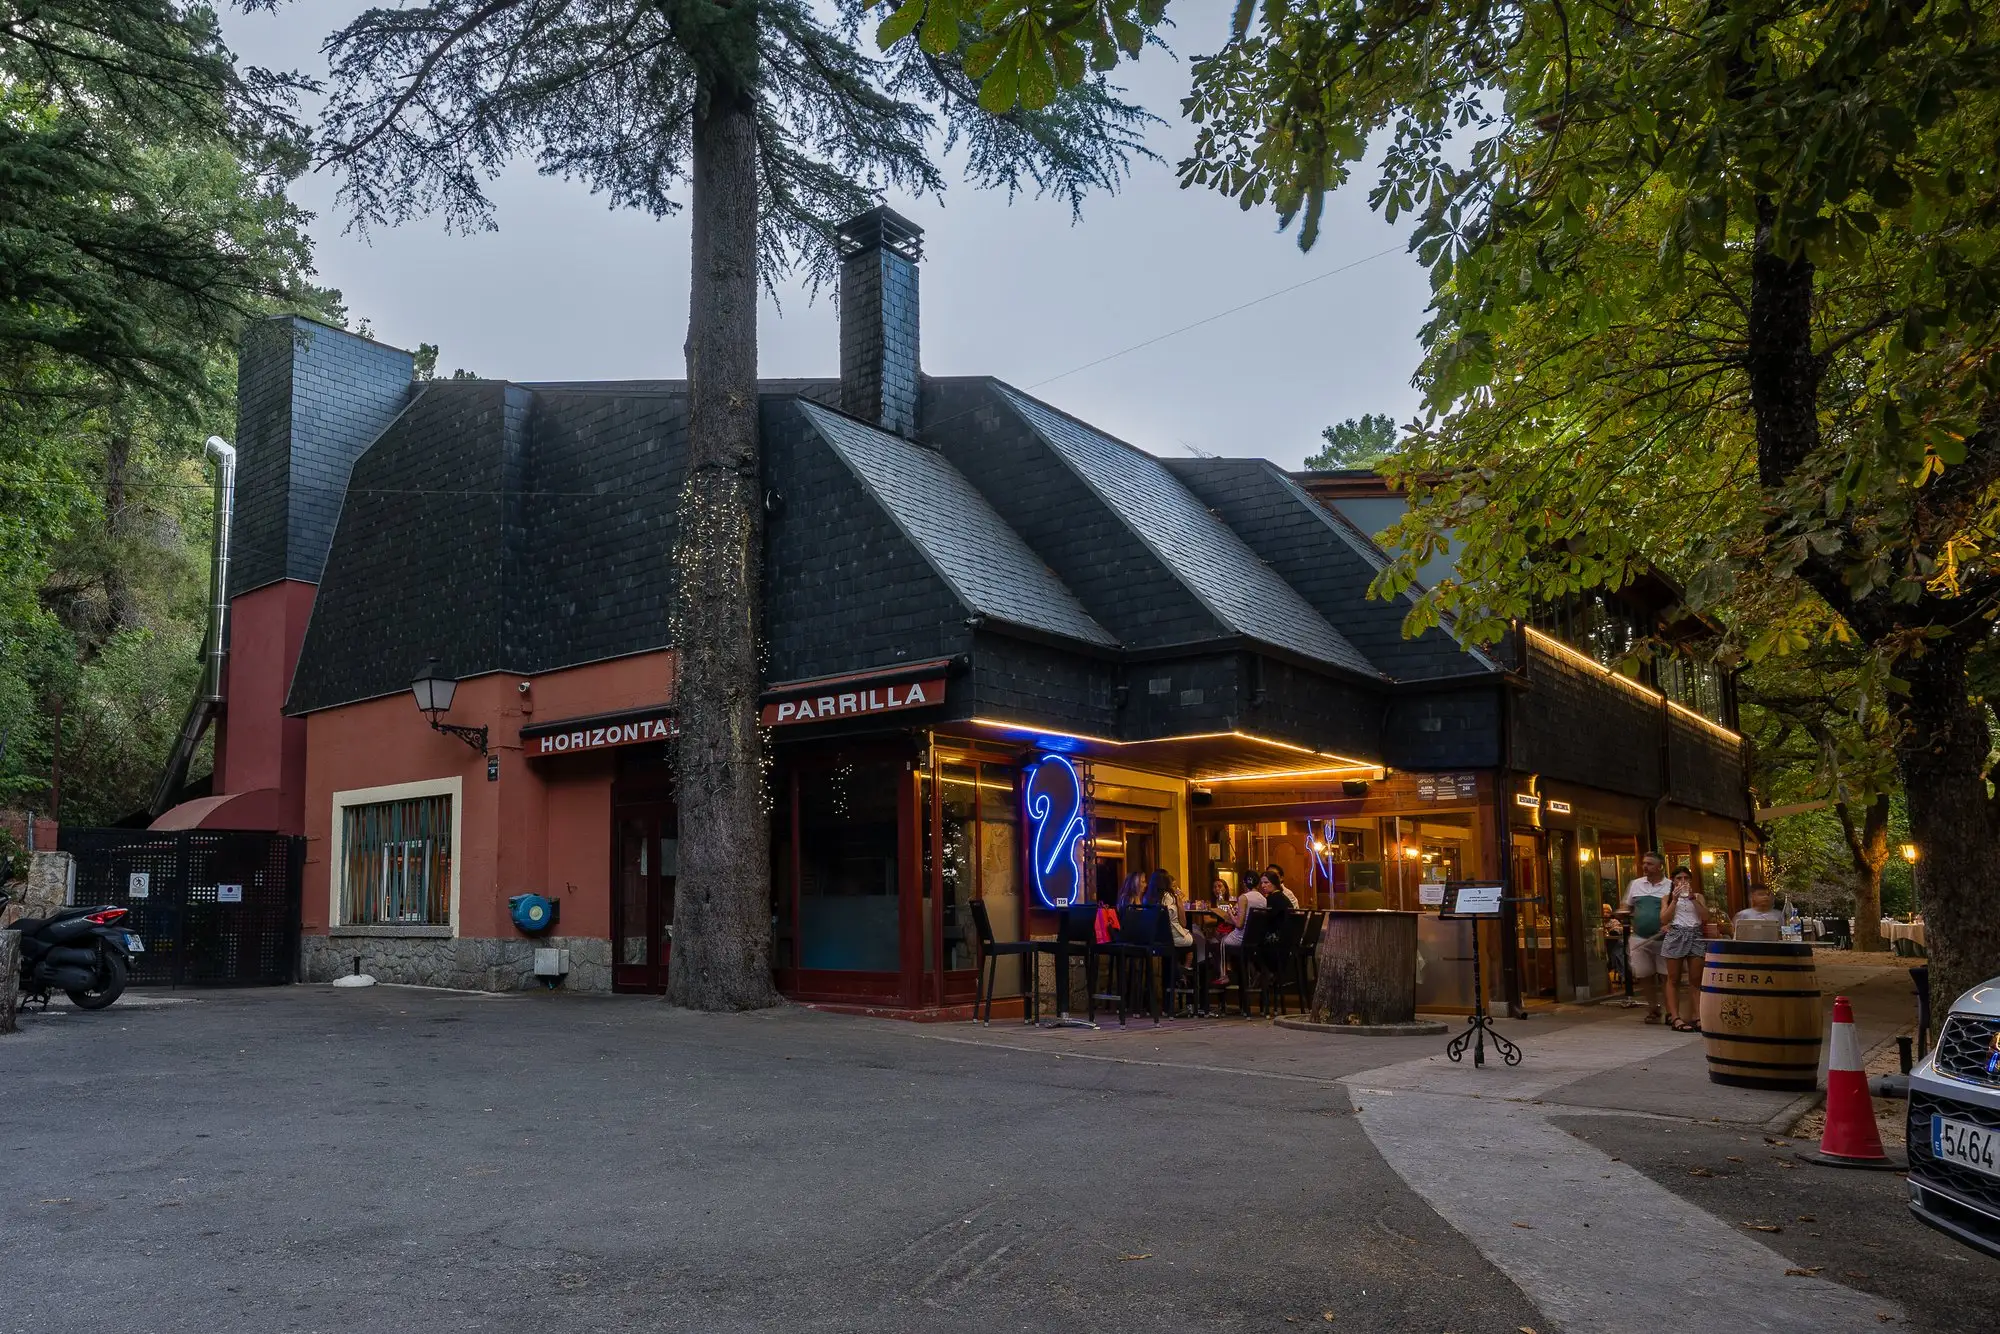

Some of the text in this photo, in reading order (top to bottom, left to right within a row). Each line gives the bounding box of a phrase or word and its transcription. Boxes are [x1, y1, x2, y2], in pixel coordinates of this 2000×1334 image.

[777, 683, 926, 721] PARRILLA
[541, 719, 680, 752] HORIZONTAL
[1711, 972, 1774, 985] TIERRA
[1944, 1123, 1993, 1169] 5464
